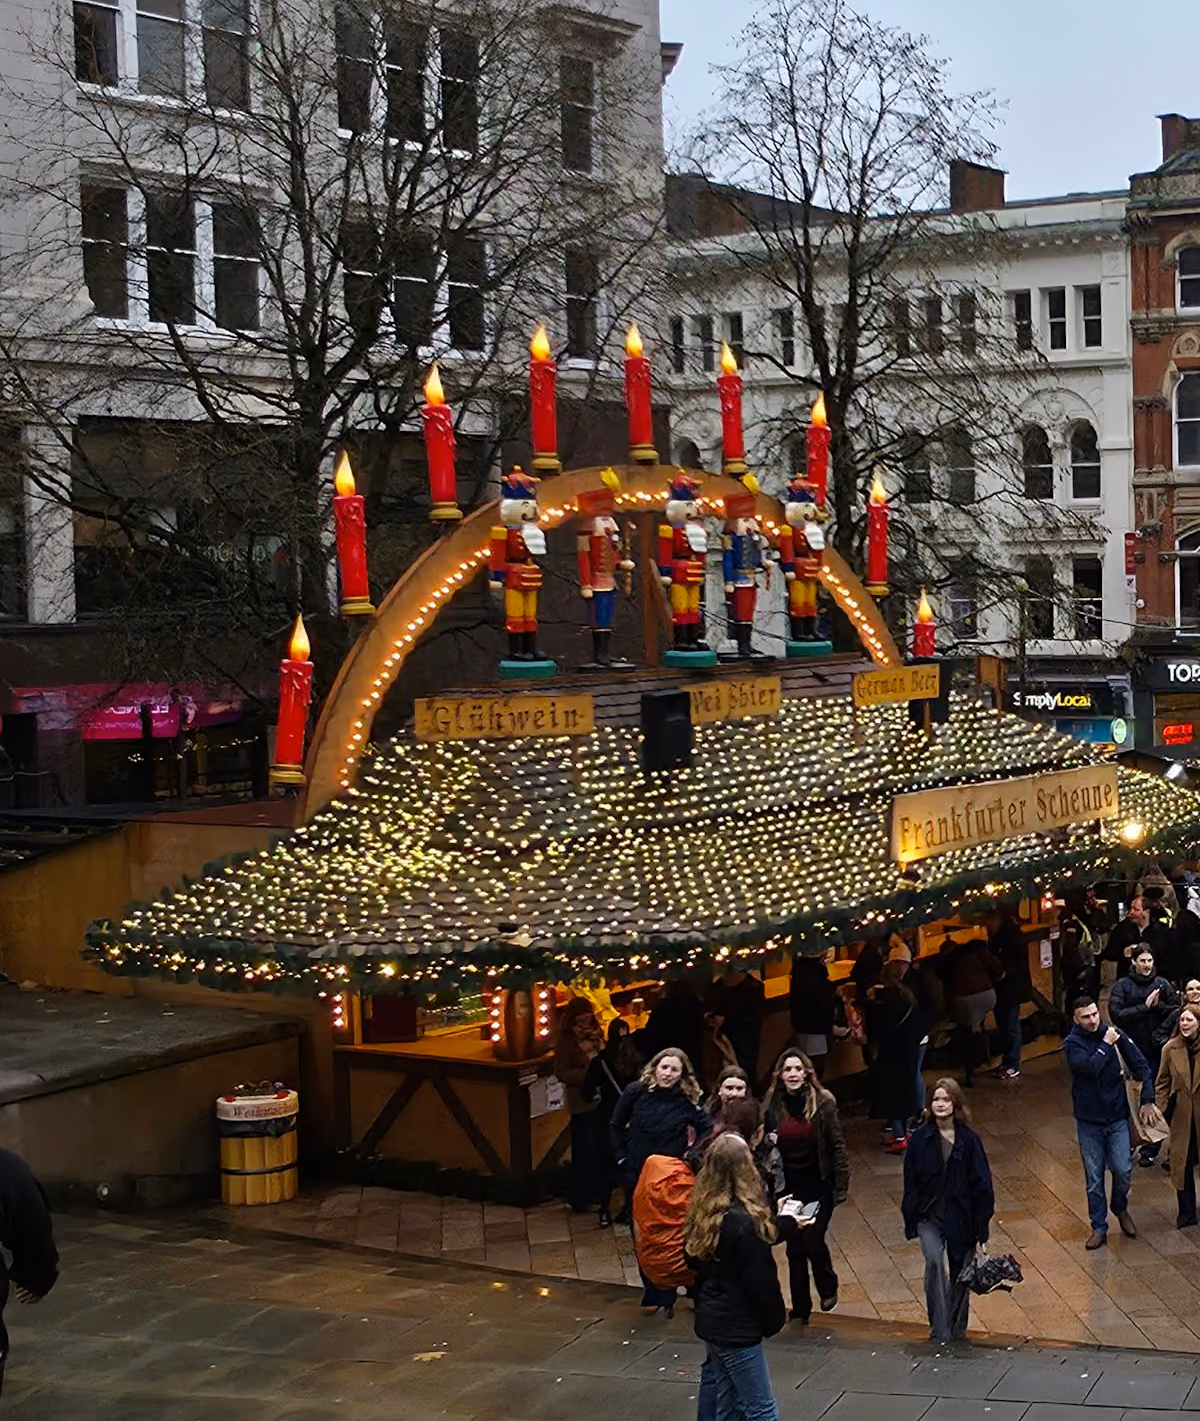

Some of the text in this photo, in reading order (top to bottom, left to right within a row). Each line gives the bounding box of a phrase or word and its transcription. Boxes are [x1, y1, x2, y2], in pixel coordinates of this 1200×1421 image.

[432, 700, 580, 734] Glühwein
[899, 783, 1113, 853] Frankfurter Scheune
